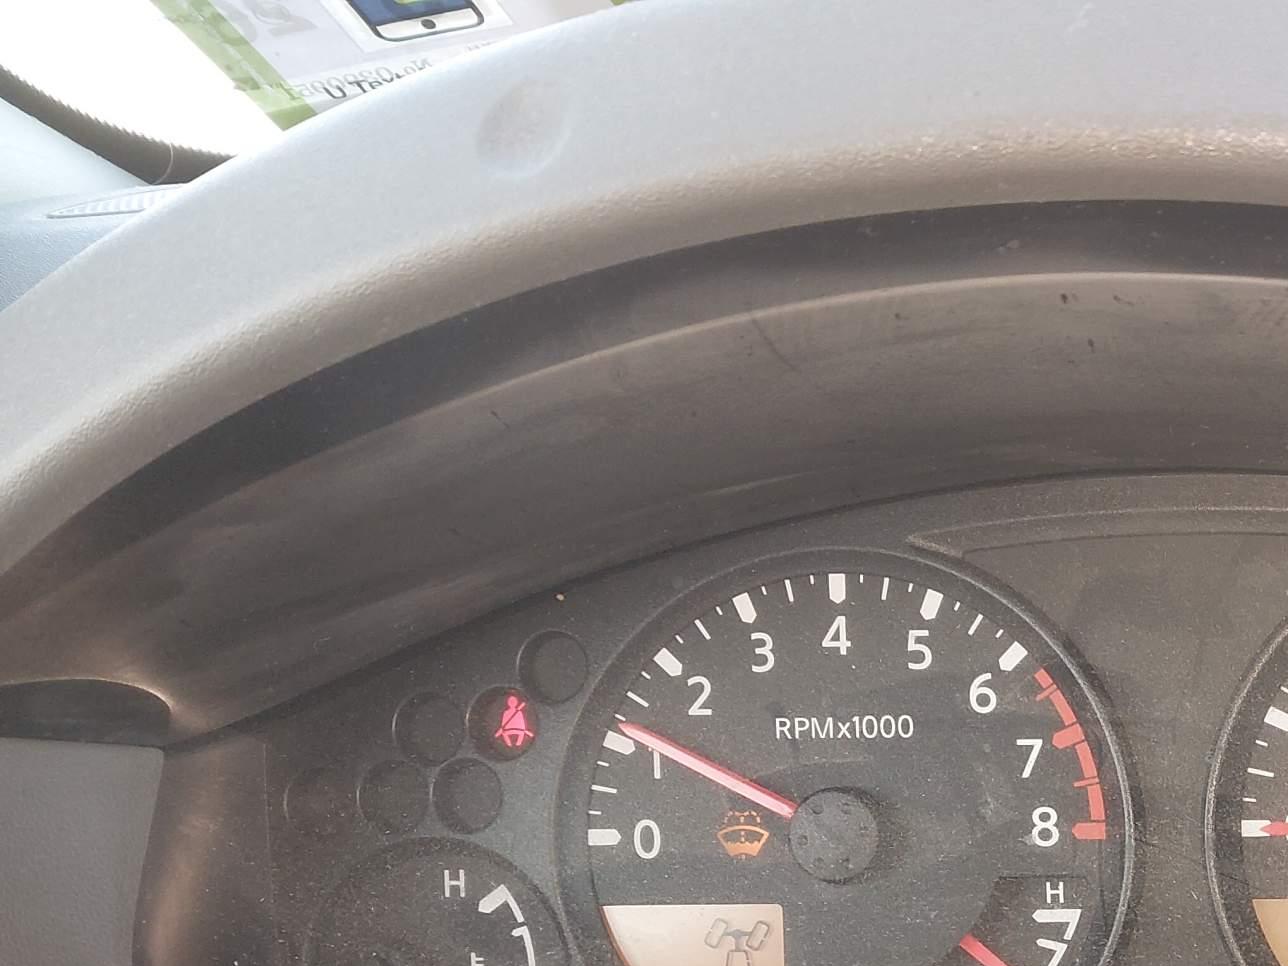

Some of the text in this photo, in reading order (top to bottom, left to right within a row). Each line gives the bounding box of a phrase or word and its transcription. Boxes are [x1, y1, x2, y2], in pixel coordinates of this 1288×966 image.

[750, 632, 775, 673] 3
[821, 615, 852, 656] 4
[907, 629, 933, 670] 5
[687, 675, 713, 716] 2
[969, 672, 997, 714] 6
[775, 714, 914, 740] RPMx1000
[1016, 738, 1043, 779] 7
[633, 819, 661, 859] 0
[1031, 806, 1060, 847] 8
[444, 869, 466, 898] H
[1045, 881, 1065, 904] H
